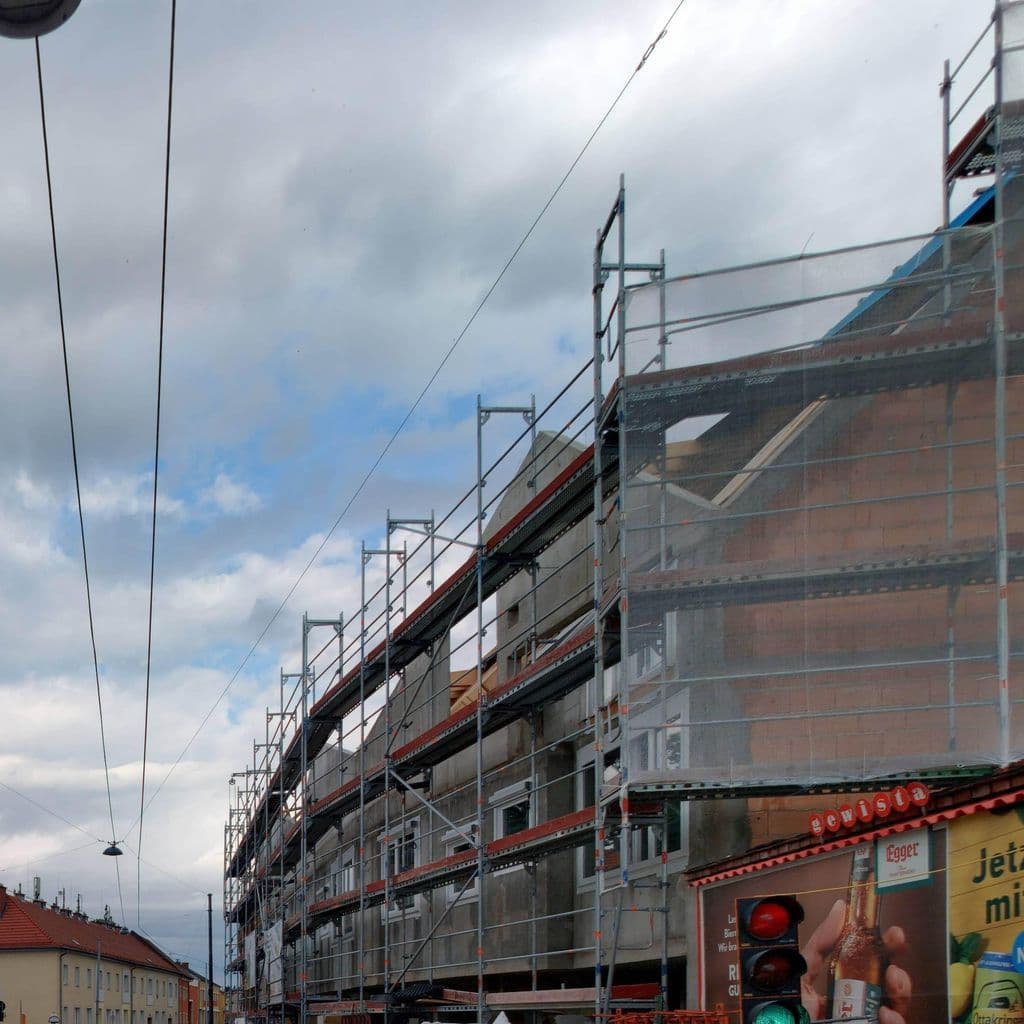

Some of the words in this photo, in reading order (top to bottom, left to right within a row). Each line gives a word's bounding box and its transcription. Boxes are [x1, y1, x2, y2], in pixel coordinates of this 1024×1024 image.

[811, 786, 927, 834] gewista
[886, 842, 920, 864] Egger
[985, 881, 1024, 925] mi
